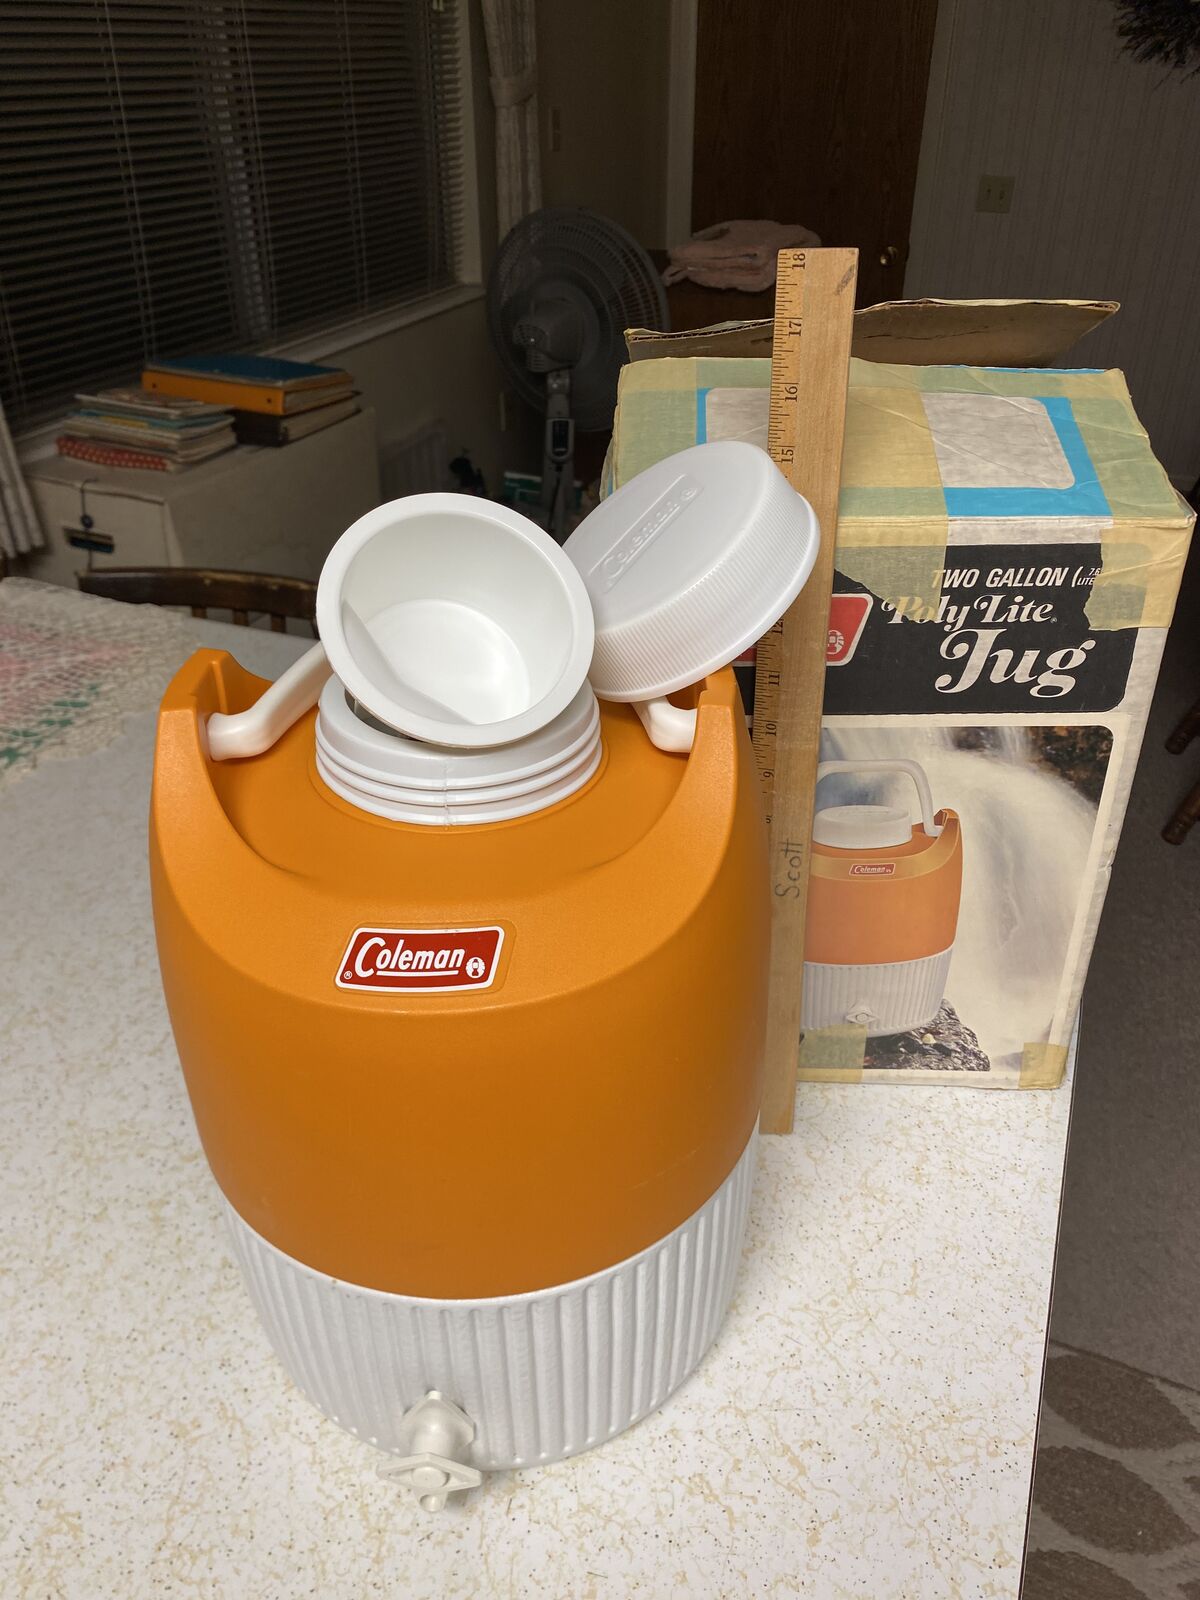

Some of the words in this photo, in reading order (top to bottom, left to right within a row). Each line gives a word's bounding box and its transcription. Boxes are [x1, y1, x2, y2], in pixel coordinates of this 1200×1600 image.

[792, 252, 806, 270] 18
[788, 320, 802, 337] 17
[784, 385, 798, 402] 16
[780, 448, 794, 464] 15
[931, 568, 980, 589] TWO
[985, 567, 1070, 587] GALLON
[881, 594, 971, 632] Poly
[973, 594, 1054, 624] Lite
[934, 628, 1097, 699] Jug
[768, 673, 780, 687] 11
[765, 723, 777, 737] 10
[774, 838, 803, 899] Scott
[854, 865, 886, 874] Coleman
[354, 936, 466, 978] Coleman
